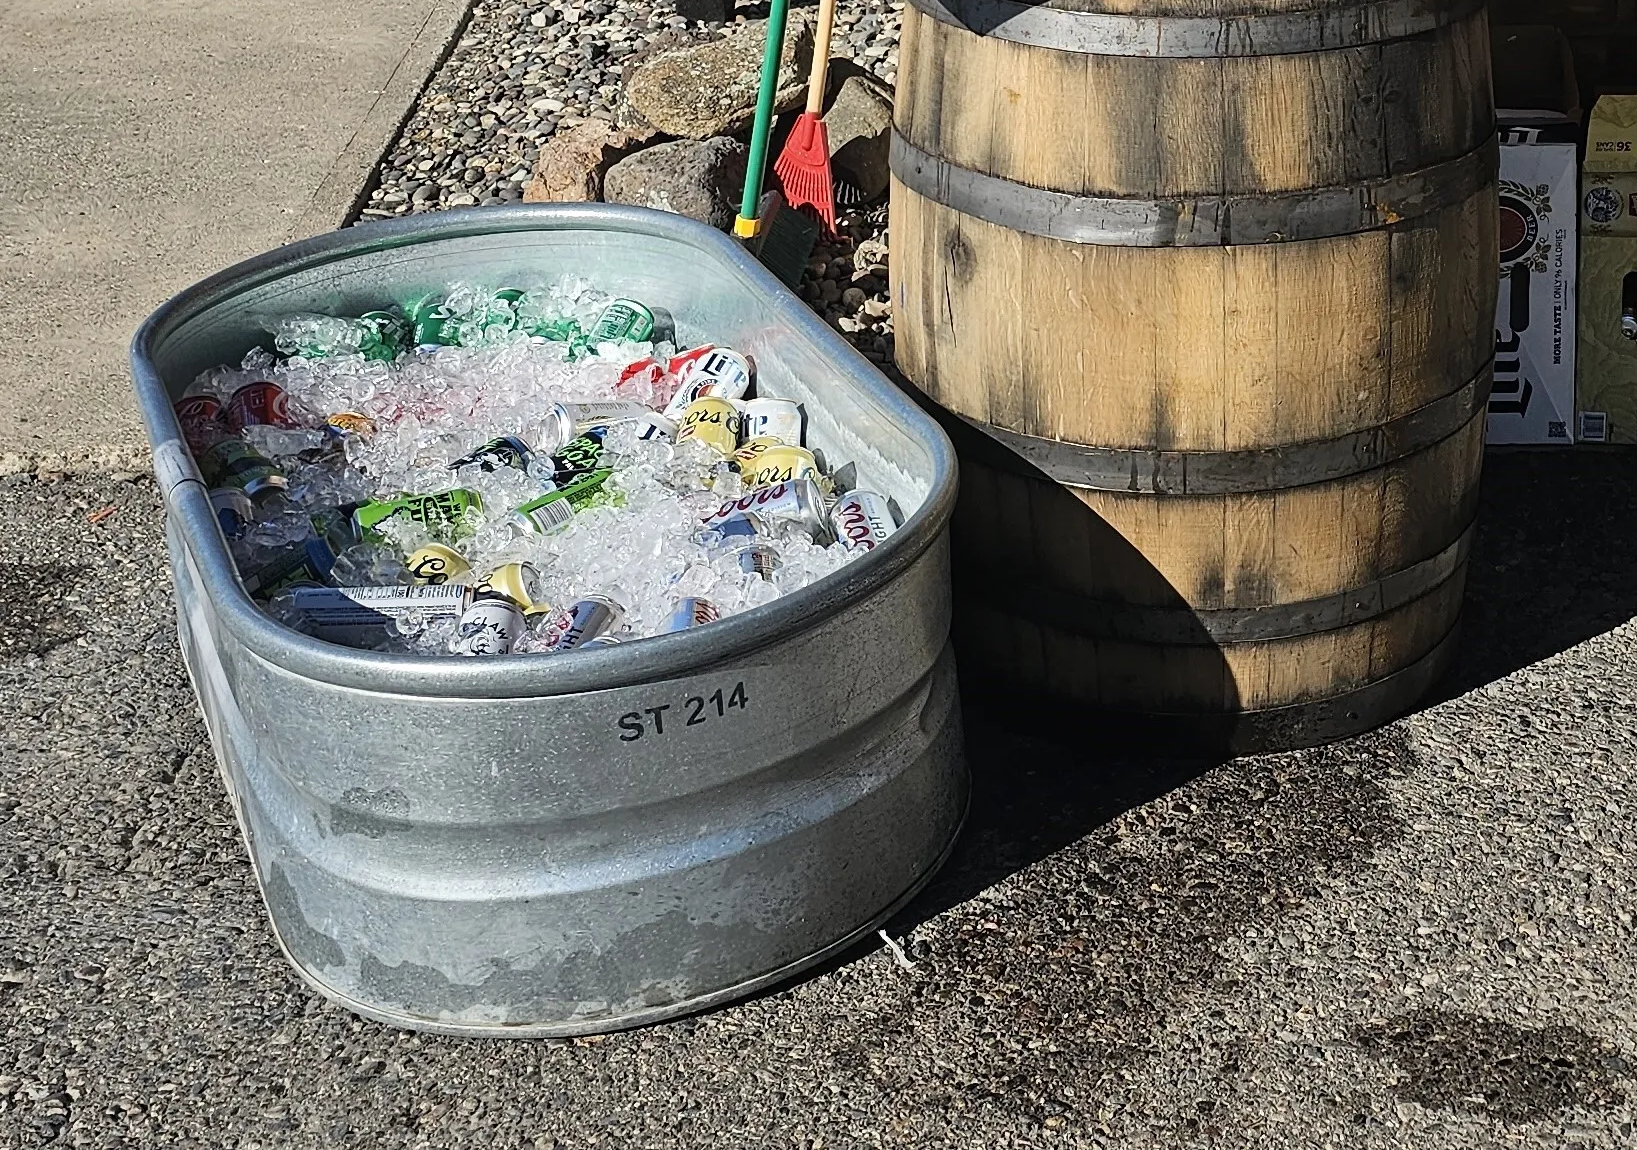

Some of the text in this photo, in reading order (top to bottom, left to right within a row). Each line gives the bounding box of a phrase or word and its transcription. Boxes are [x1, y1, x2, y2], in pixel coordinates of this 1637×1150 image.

[1616, 141, 1632, 152] 36
[1526, 213, 1536, 242] BEER
[1553, 229, 1563, 365] MORE TASTE ONLY 96 CALORIES
[683, 409, 722, 427] ors
[756, 465, 793, 485] ors
[700, 483, 788, 525] oors
[838, 501, 876, 551] oors
[472, 616, 509, 640] CLAW
[618, 681, 749, 742] ST 214
